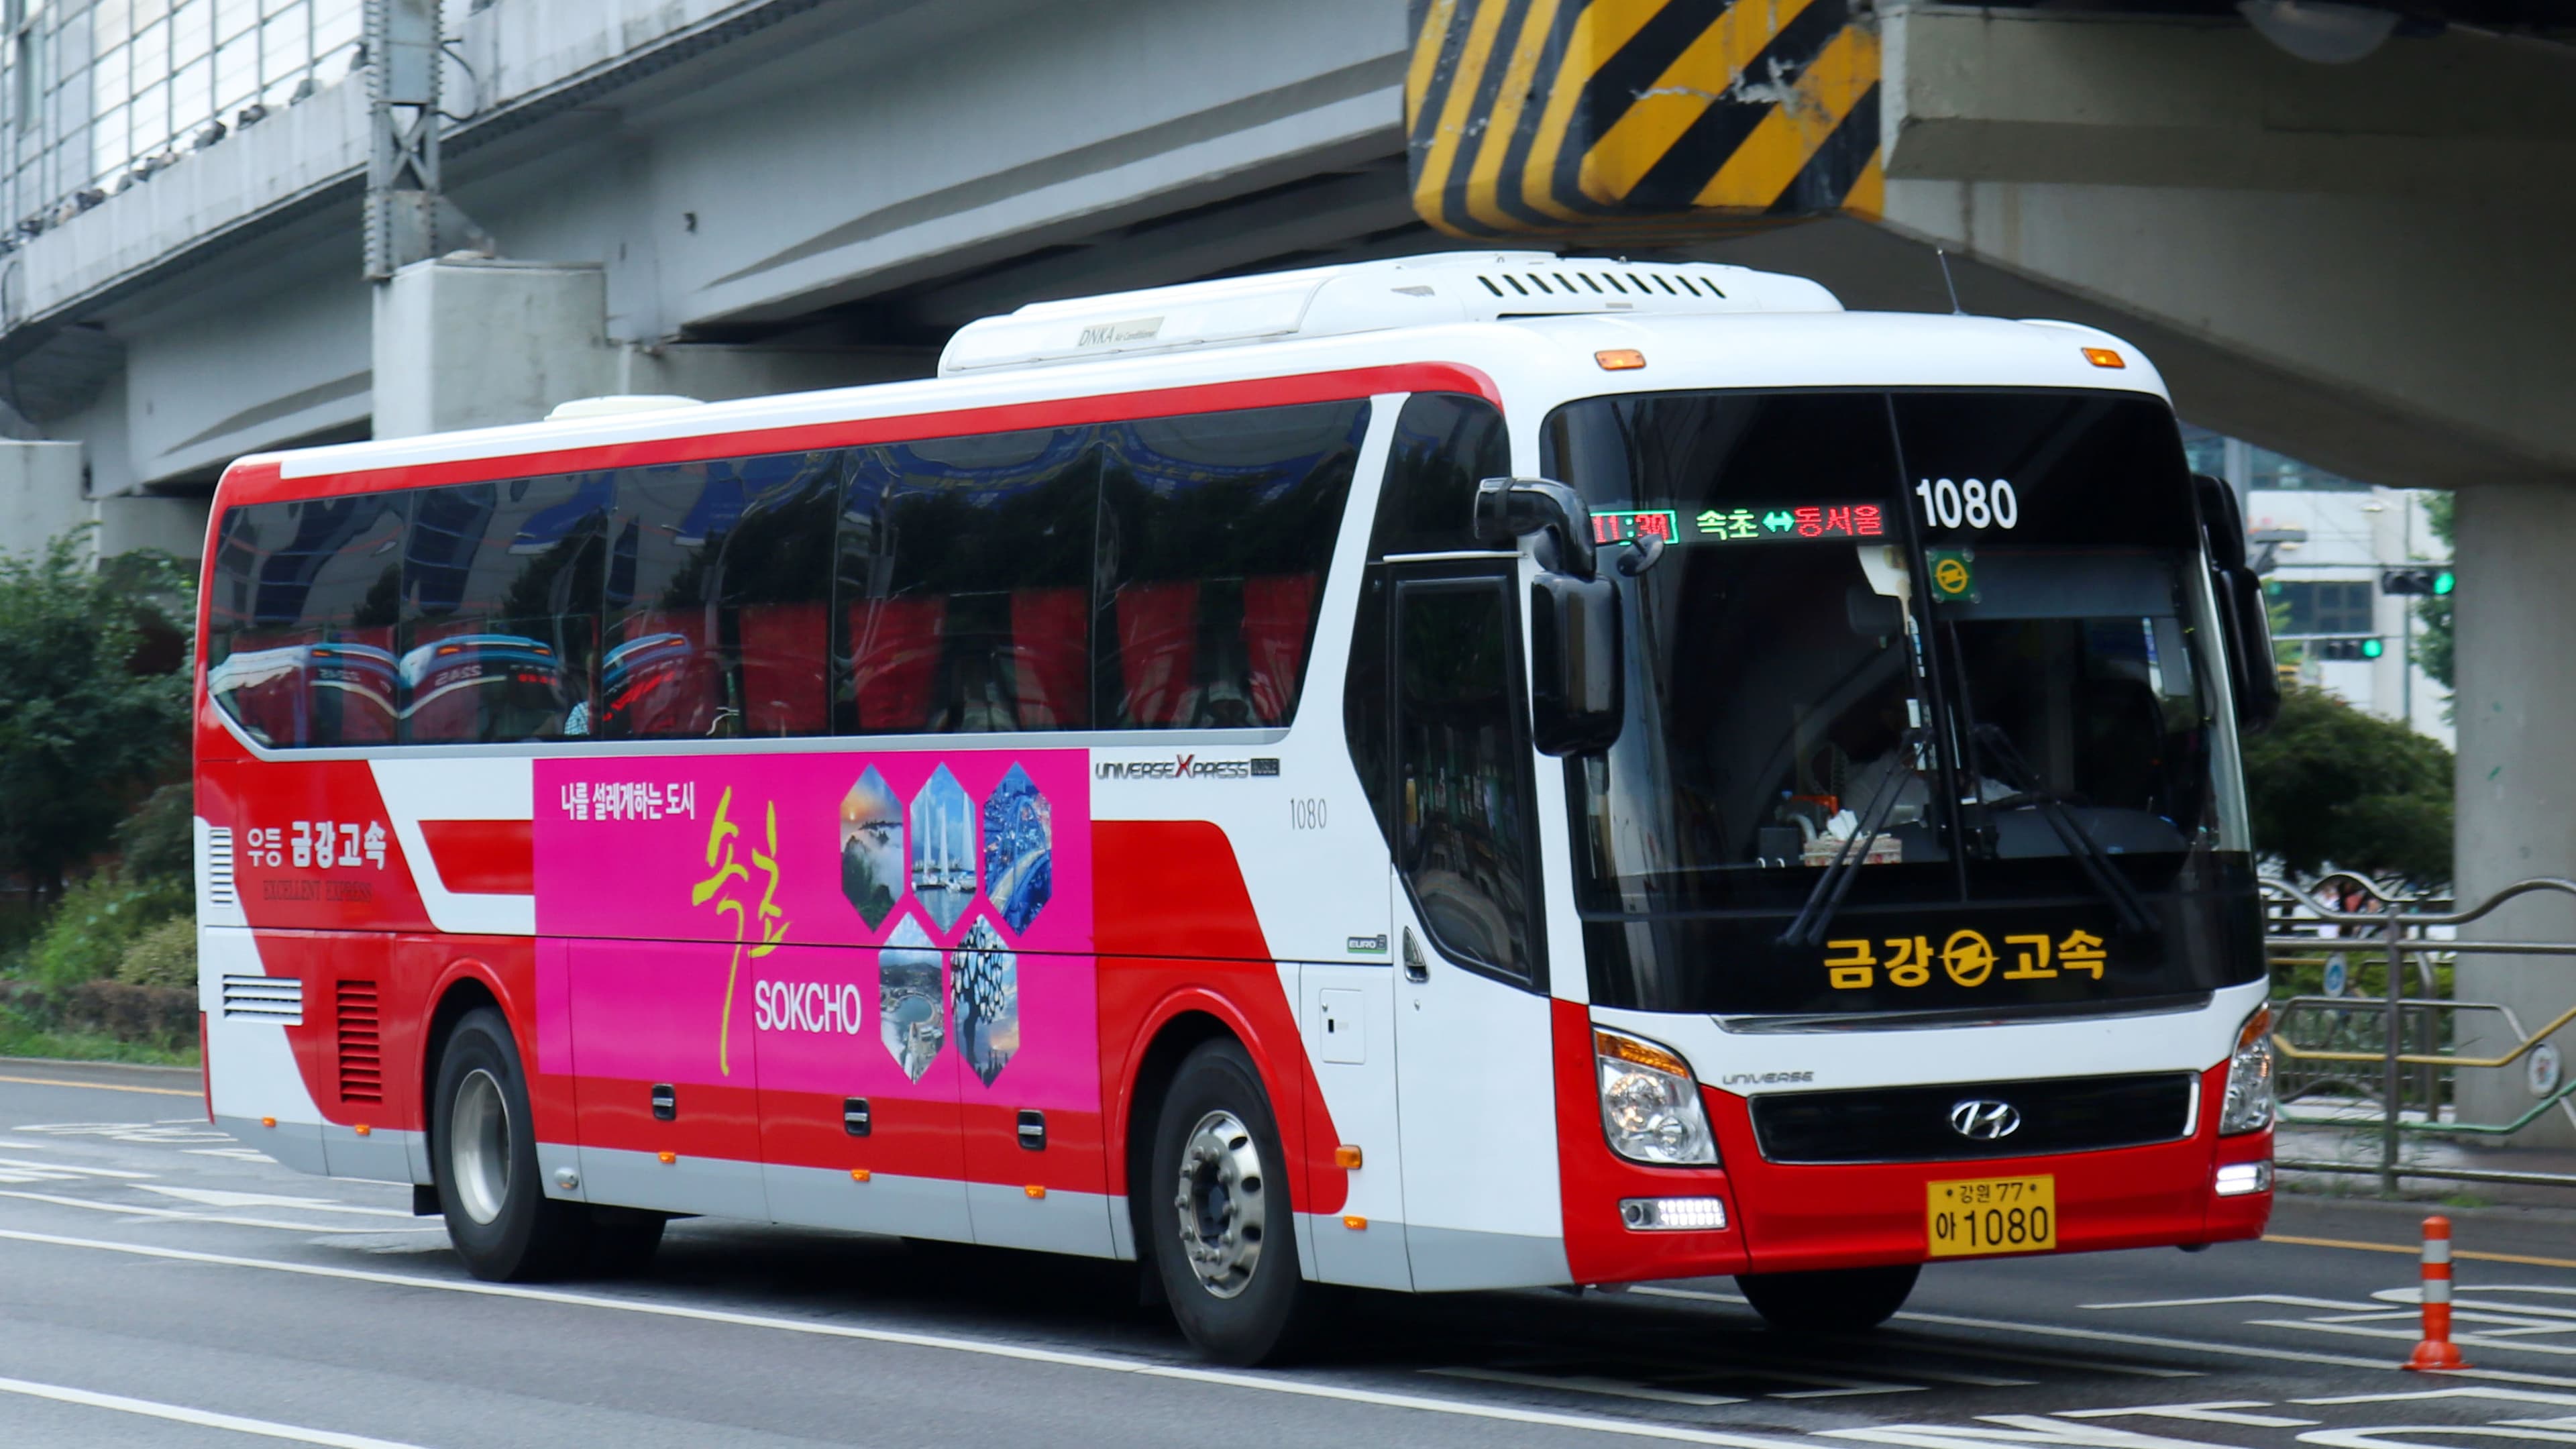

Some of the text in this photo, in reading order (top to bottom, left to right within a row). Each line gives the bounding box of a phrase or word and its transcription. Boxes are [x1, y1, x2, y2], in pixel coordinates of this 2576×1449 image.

[1696, 504, 1882, 540] 속초 동서울
[1916, 478, 2017, 529] 1080
[561, 781, 695, 820] 나를 설레게하는 도시
[1291, 798, 1327, 830] 1080
[248, 820, 386, 870] 우등 금강고속
[1824, 929, 2107, 989] 금강 고속
[755, 979, 861, 1034] SOKCHO
[1723, 1071, 1815, 1085] UNIVERSE
